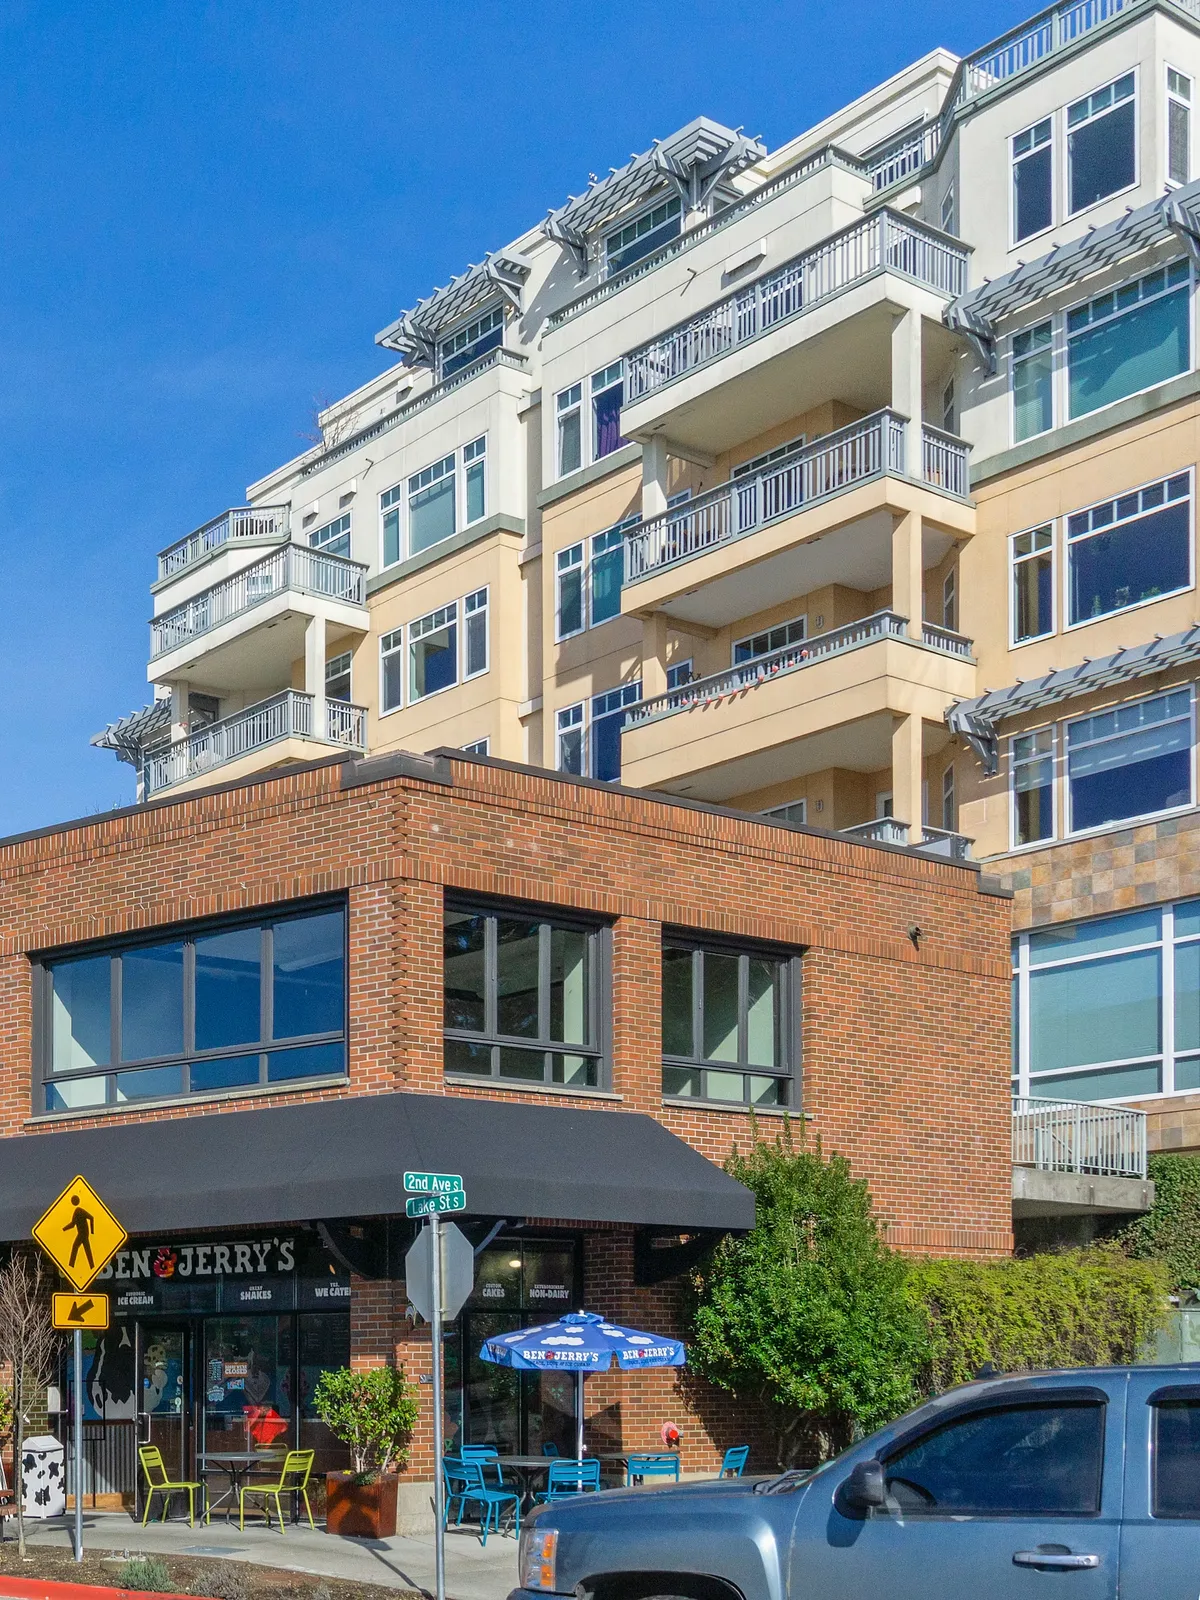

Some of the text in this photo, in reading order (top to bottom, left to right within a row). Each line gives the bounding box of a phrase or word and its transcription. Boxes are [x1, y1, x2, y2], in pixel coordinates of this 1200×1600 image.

[408, 1175, 428, 1190] 2nd
[432, 1176, 451, 1191] Ave
[412, 1199, 435, 1215] Lake
[440, 1195, 451, 1210] St
[178, 1237, 295, 1277] JERRY'S
[240, 1290, 272, 1301] SHAKES
[482, 1288, 505, 1298] CAKES
[529, 1289, 570, 1299] NON-DAIRY
[118, 1296, 154, 1306] ICE CREAM
[523, 1350, 546, 1360] BEN
[554, 1352, 599, 1362] JERRY'S
[623, 1350, 639, 1360] BEN
[645, 1346, 675, 1358] JERRY'S
